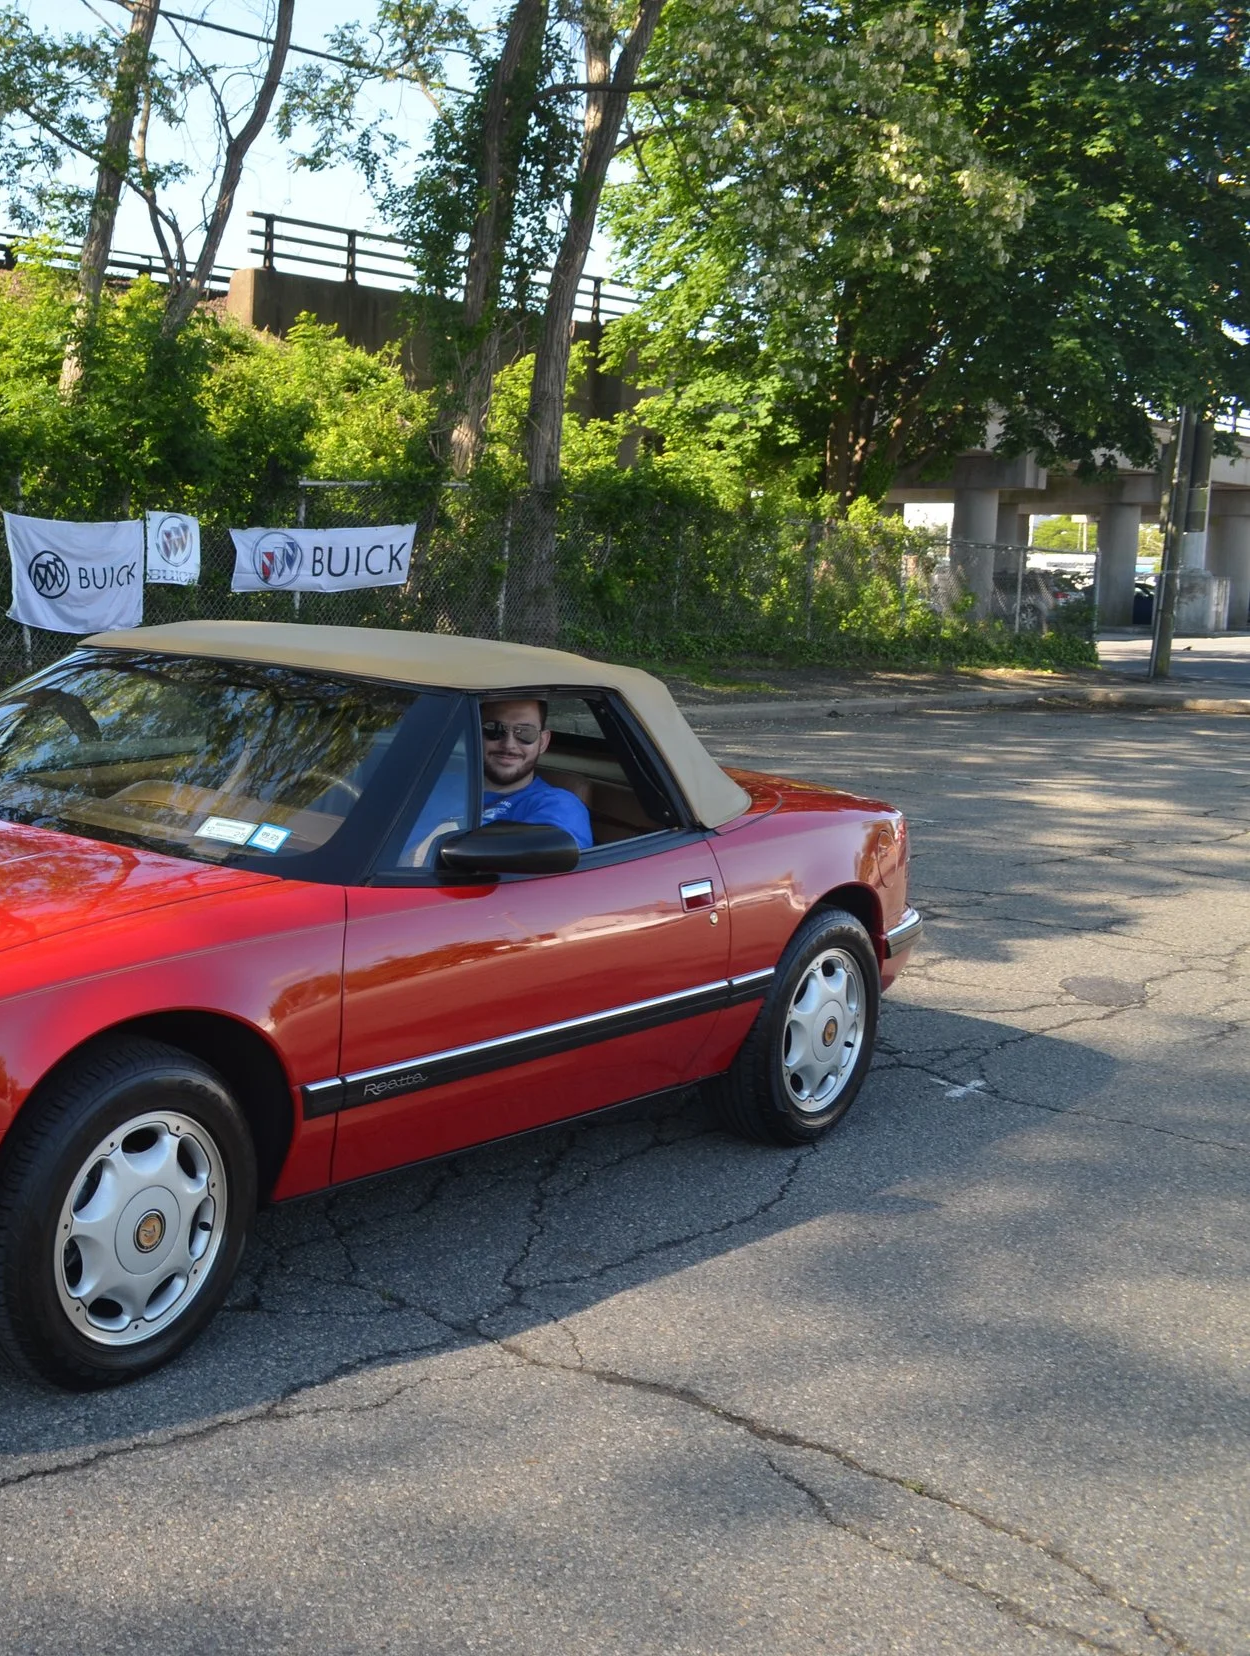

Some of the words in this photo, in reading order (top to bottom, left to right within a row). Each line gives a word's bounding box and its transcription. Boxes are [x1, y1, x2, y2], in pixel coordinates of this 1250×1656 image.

[311, 542, 408, 578] BUICK
[78, 561, 137, 590] BUICK
[147, 569, 198, 584] BUICK
[363, 1073, 428, 1096] Reatta
